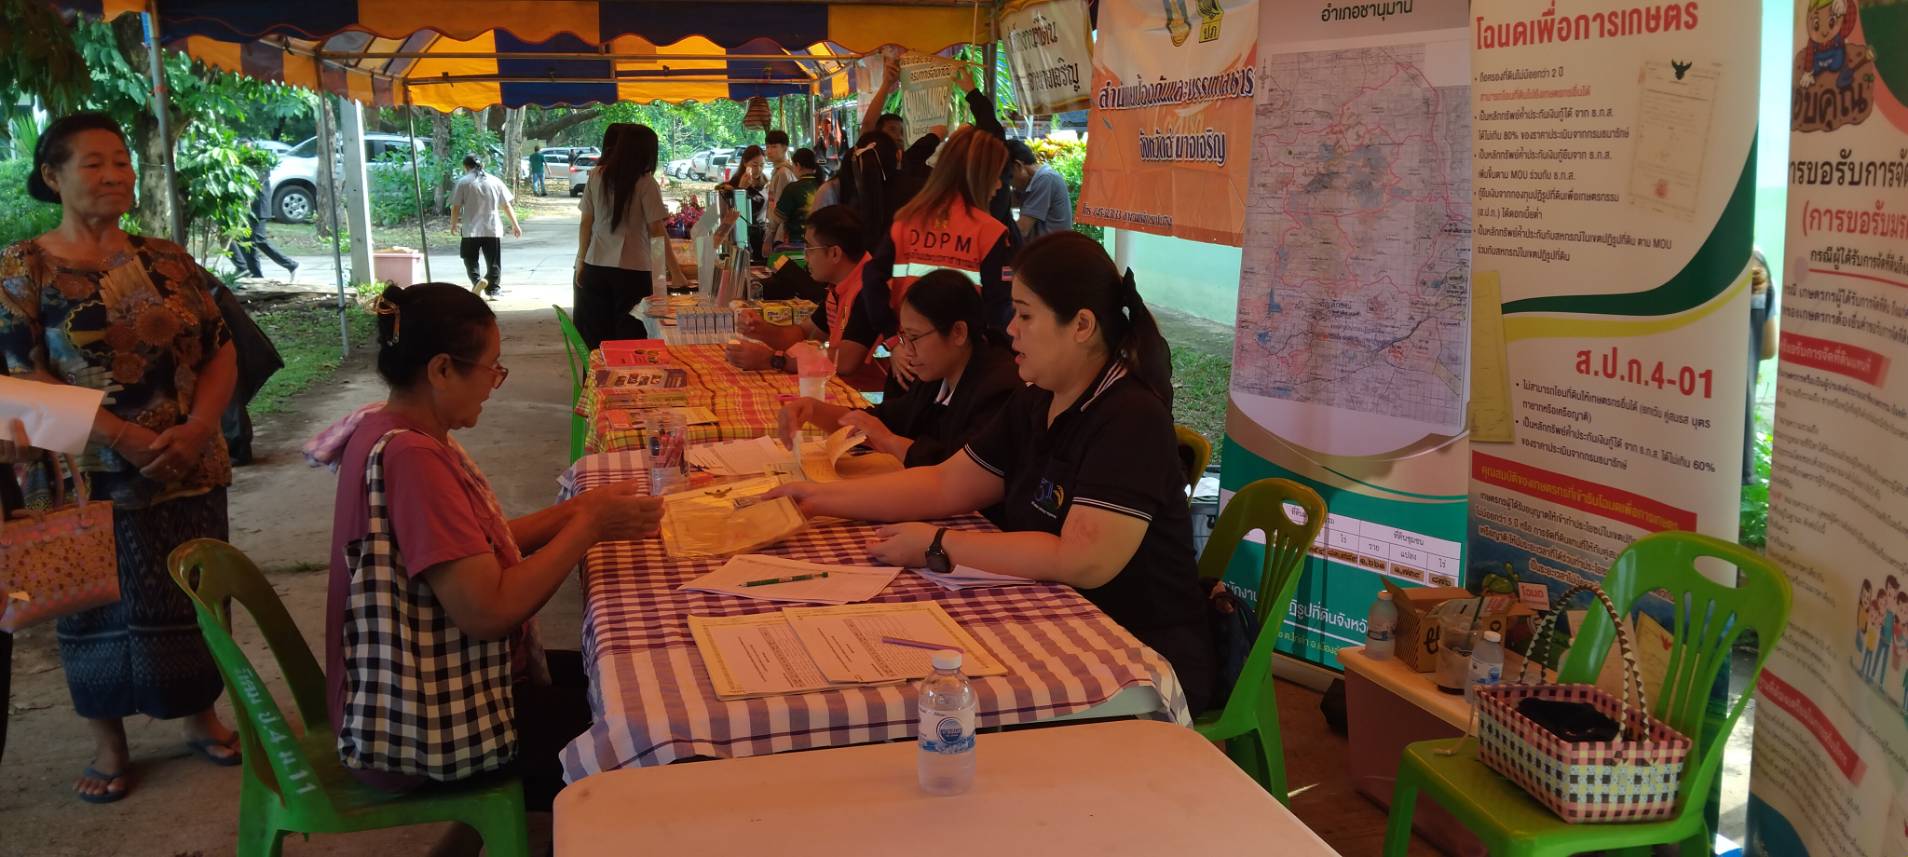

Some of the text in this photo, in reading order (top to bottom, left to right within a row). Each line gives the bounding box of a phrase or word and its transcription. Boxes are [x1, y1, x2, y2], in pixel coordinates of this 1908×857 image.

[1321, 0, 1414, 22] อำเภอชานุมาน
[1476, 1, 1699, 50] โฉนดเพื่อการเกษตร
[1552, 68, 1557, 78] 2
[1510, 170, 1528, 180] MOU
[1653, 239, 1672, 250] MOU
[1575, 347, 1713, 399] ส.ป.ก.4-01
[1691, 417, 1711, 430] บุตร
[1693, 460, 1716, 473] 60%
